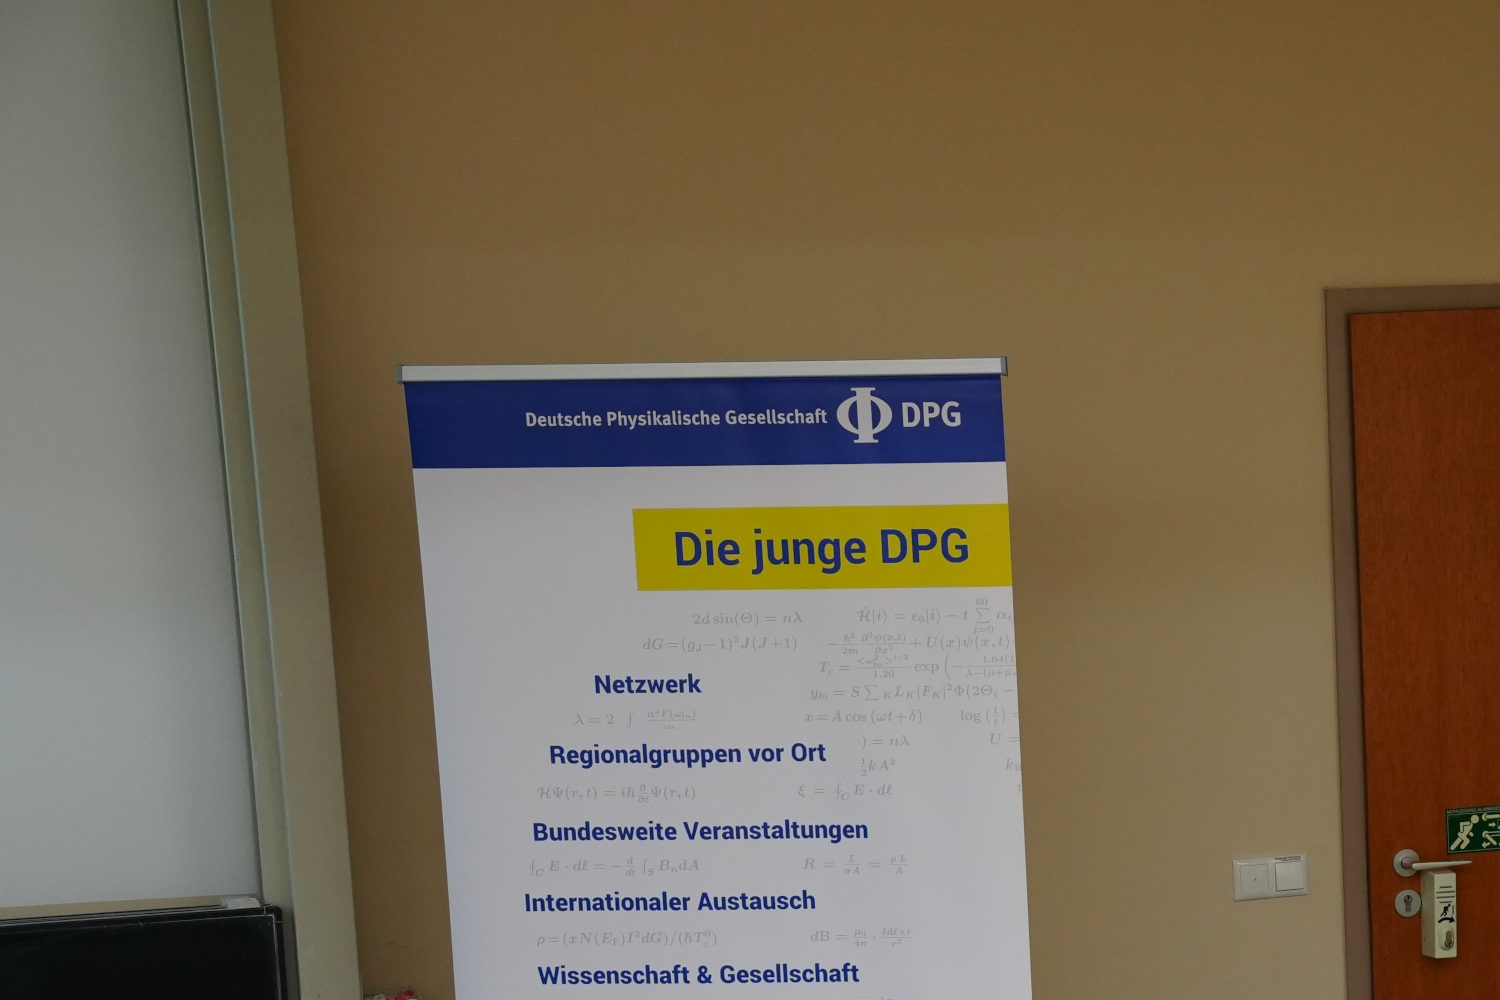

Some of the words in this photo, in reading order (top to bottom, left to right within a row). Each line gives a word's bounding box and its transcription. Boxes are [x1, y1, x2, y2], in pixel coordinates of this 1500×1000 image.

[526, 411, 602, 426] Deutsche
[607, 410, 720, 430] Physikalische
[726, 408, 827, 424] Gesellschaft
[902, 401, 961, 427] DPG
[675, 529, 740, 566] Die
[752, 529, 866, 574] junge
[881, 528, 968, 563] DPG
[595, 673, 702, 693] Netzwerk
[550, 744, 741, 769] Regionalgruppen
[748, 748, 784, 762] vor
[792, 743, 826, 761] Ort
[534, 821, 677, 841] Bundesweite
[683, 819, 868, 843] Veranstaltungen
[525, 892, 690, 912] Internationaler
[698, 890, 815, 910] Austausch
[538, 964, 690, 984] Wissenschaft
[697, 966, 712, 984] &
[720, 963, 859, 983] Gesellschaft
